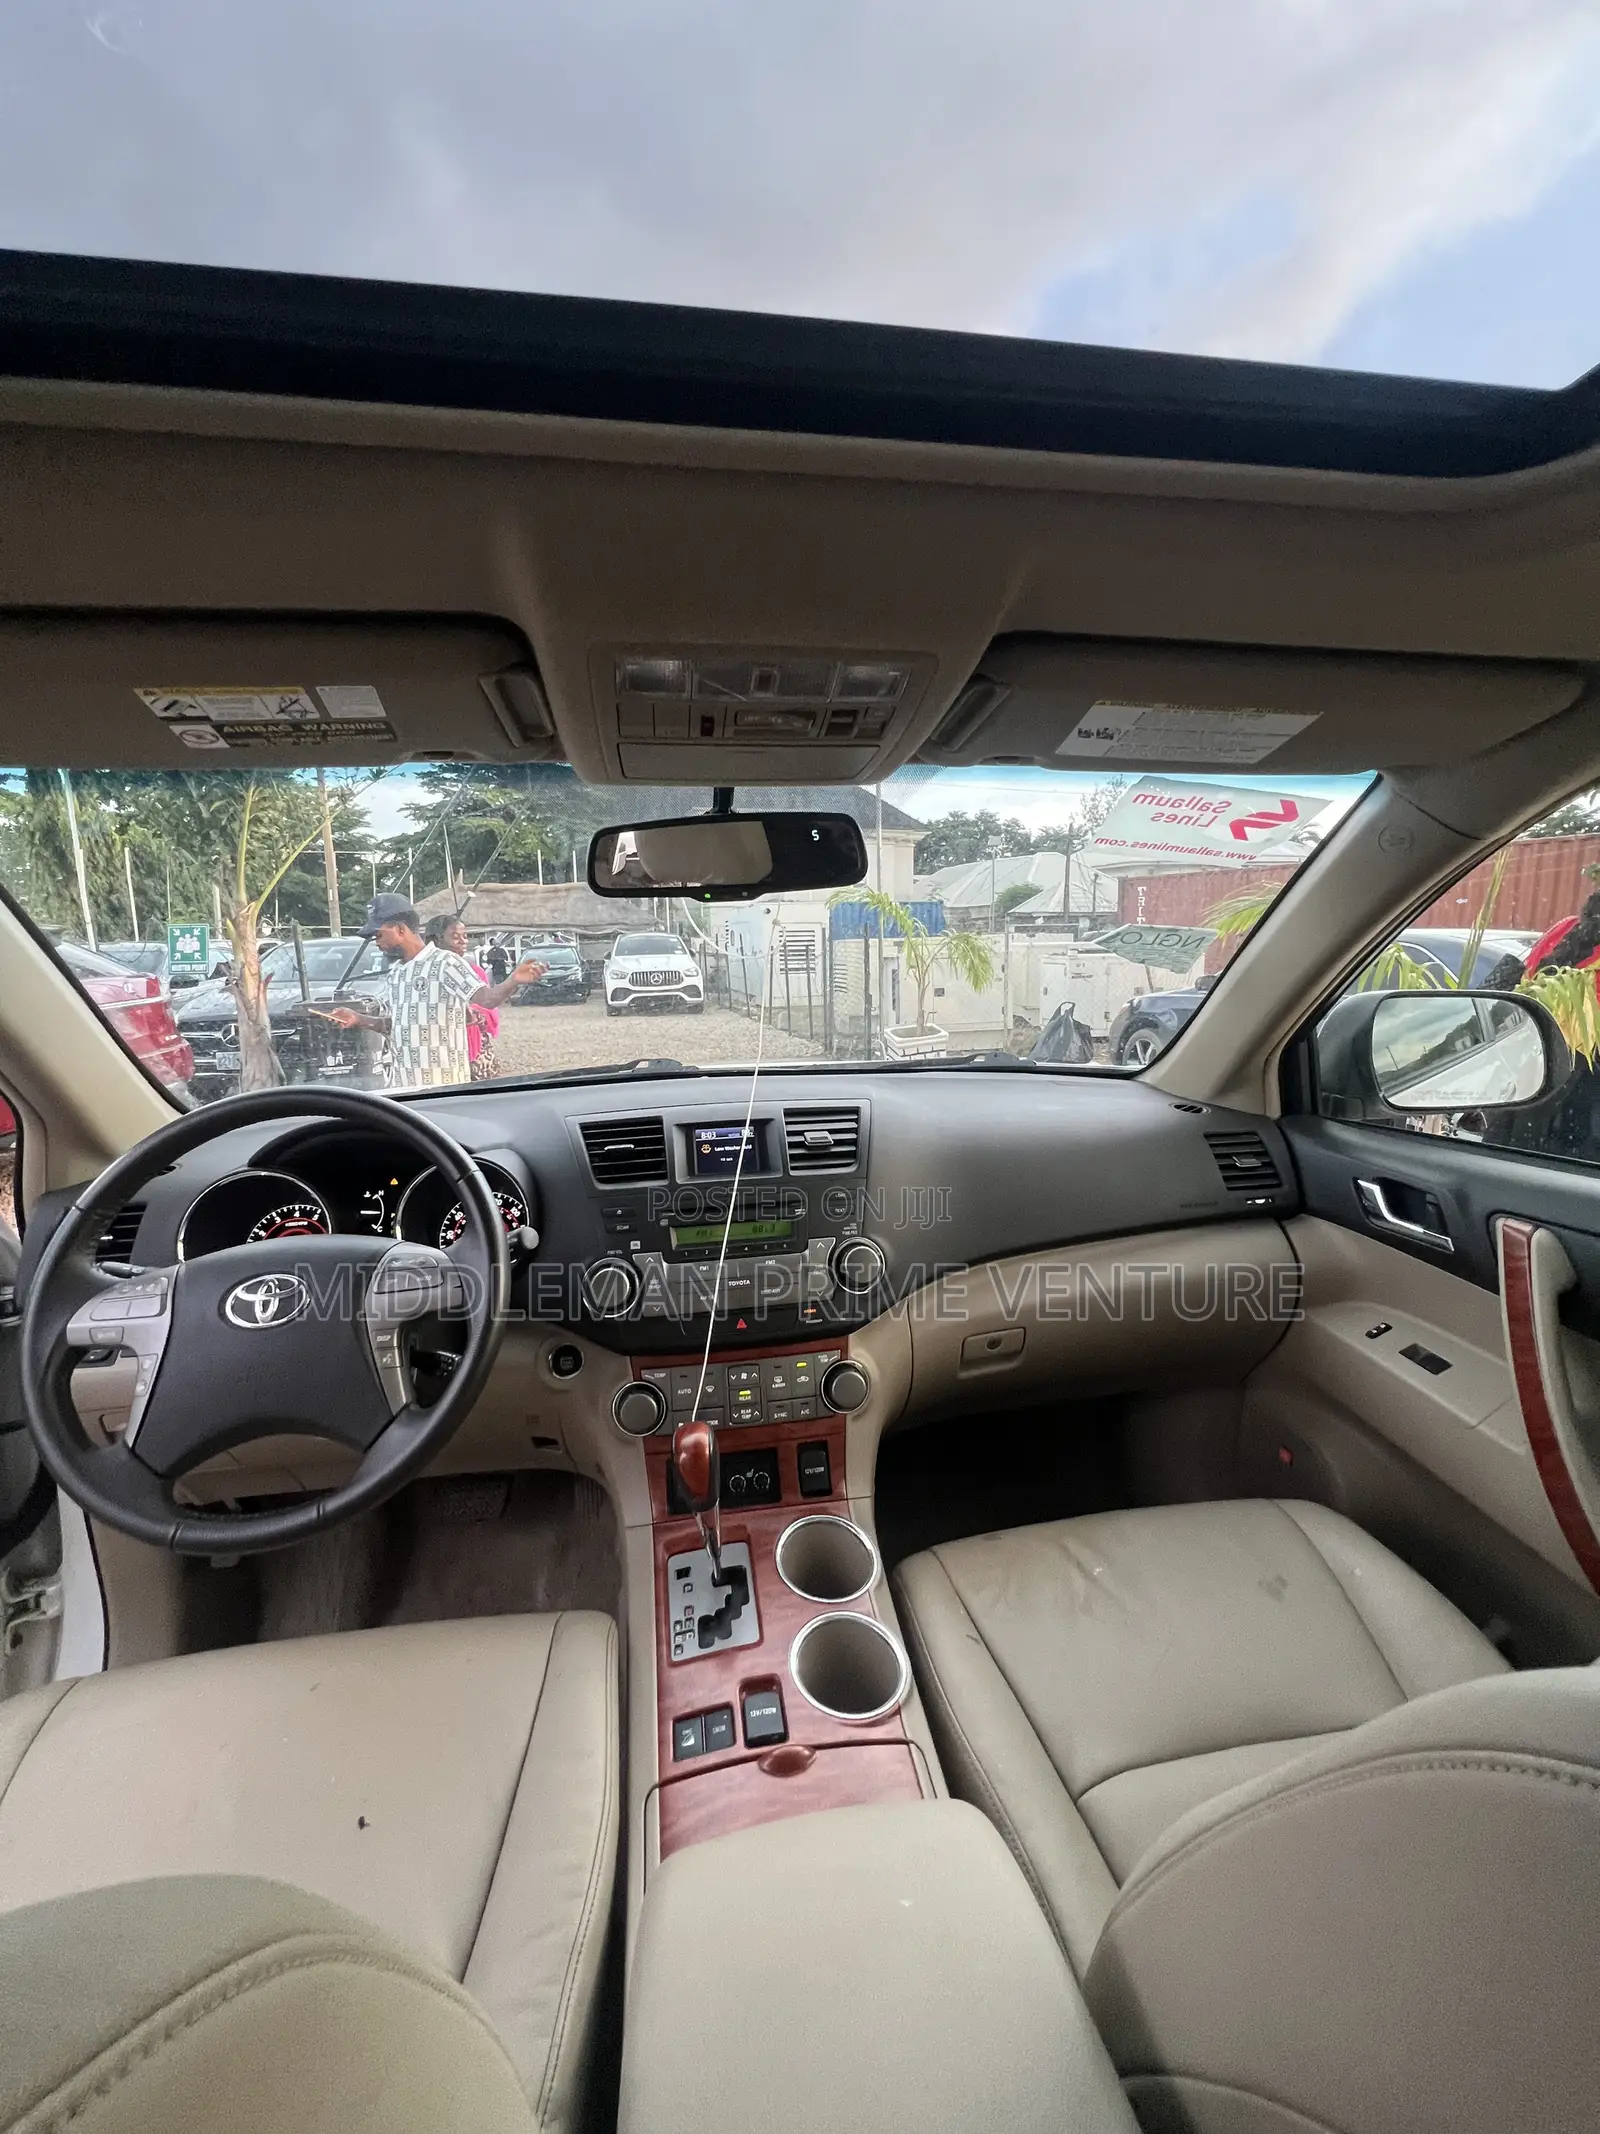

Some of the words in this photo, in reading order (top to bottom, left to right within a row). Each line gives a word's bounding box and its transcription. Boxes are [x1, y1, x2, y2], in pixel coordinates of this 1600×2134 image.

[223, 724, 293, 733] AIRBAG
[300, 722, 387, 731] WARNING
[701, 1131, 716, 1139] 8:03
[294, 1210, 300, 1218] 4
[728, 1279, 751, 1287] TOYOTA
[774, 1411, 788, 1419] SYNC
